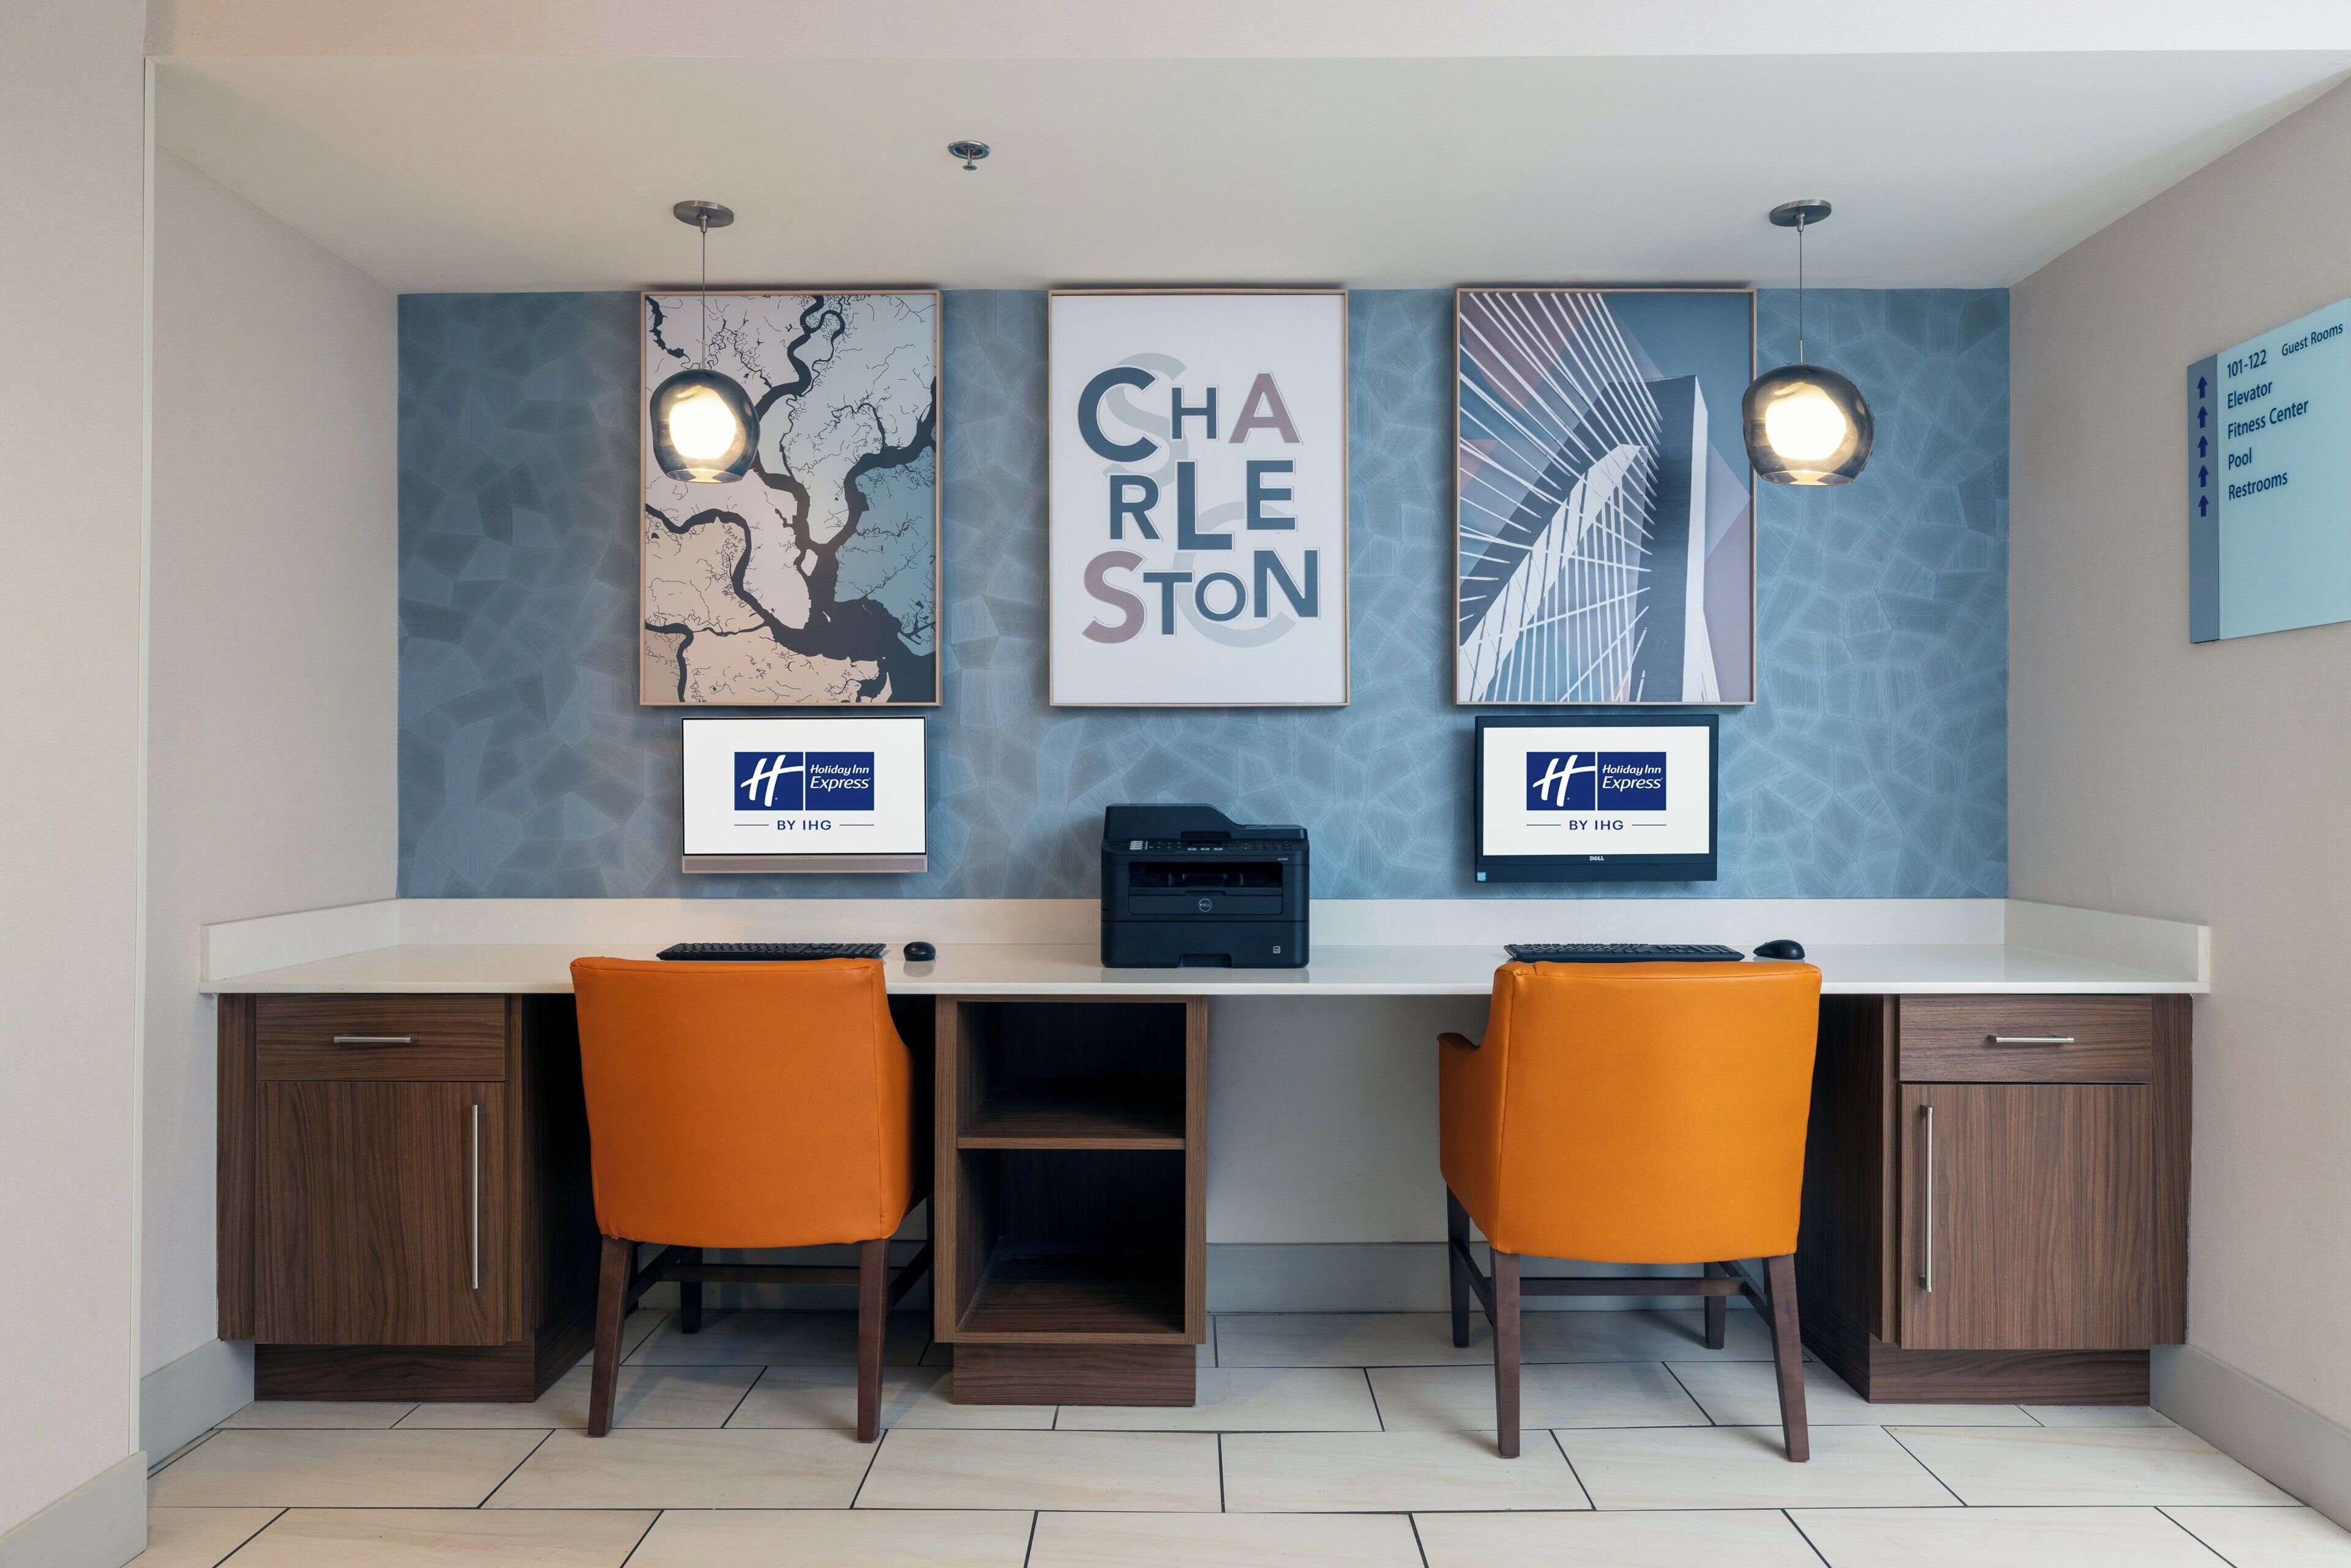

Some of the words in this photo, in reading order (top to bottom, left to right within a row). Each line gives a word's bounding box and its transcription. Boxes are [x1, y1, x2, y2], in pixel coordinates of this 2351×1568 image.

[2227, 349, 2267, 378] 101-122
[2282, 337, 2308, 356] Guest
[2311, 324, 2343, 345] Rooms
[2227, 381, 2273, 409] Elevator
[2228, 416, 2266, 440] Fitness
[2270, 400, 2309, 424] Center
[2229, 447, 2252, 470] Pool
[2229, 473, 2288, 501] Restrooms
[809, 764, 851, 776] Holiday
[852, 764, 869, 774] Inn
[1602, 764, 1643, 776] Holiday
[1644, 764, 1662, 774] Inn
[810, 776, 870, 792] Express
[1602, 776, 1662, 792] Express
[778, 820, 796, 830] BY
[803, 820, 831, 830] IHG
[1570, 820, 1588, 830] BY
[1595, 820, 1624, 830] IHG
